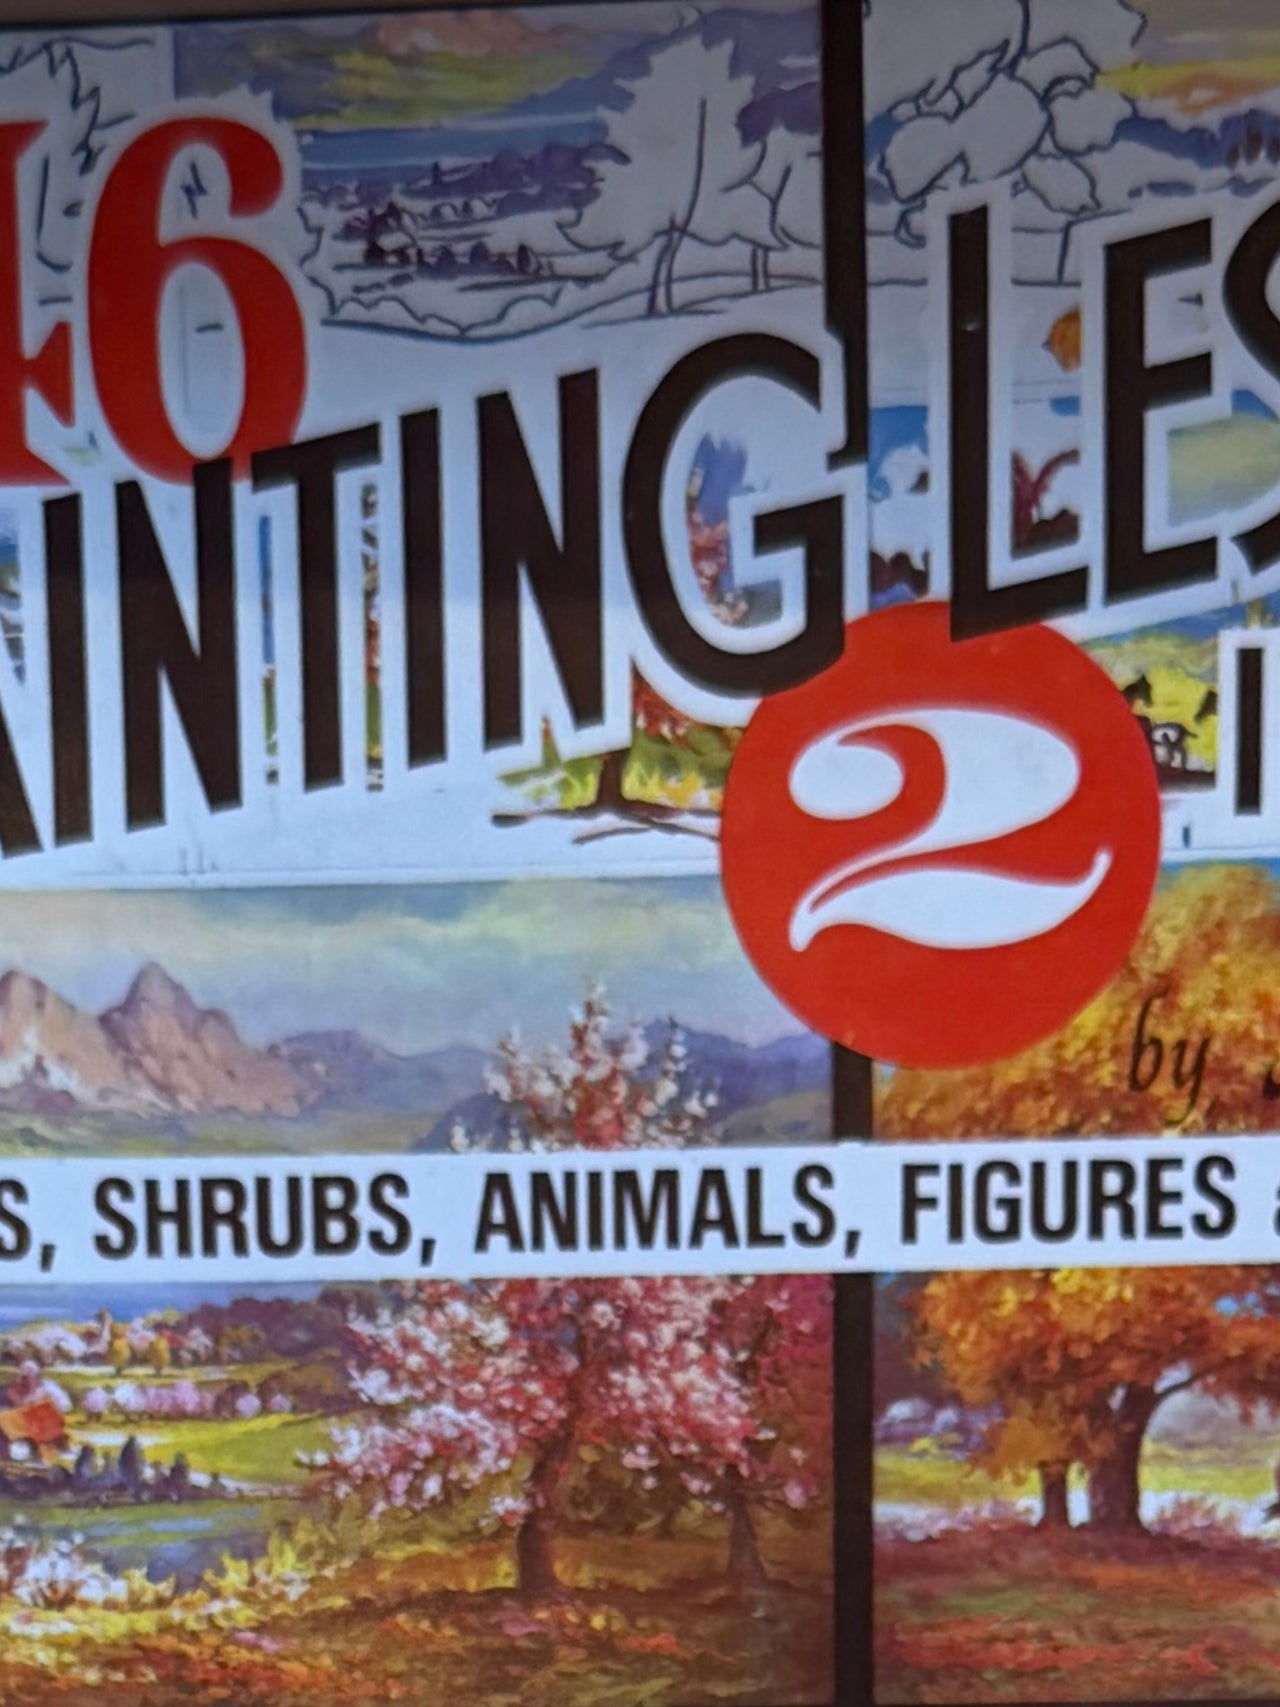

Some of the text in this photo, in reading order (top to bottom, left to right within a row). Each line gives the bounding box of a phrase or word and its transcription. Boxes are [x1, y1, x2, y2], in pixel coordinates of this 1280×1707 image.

[787, 708, 1112, 952] 2
[1128, 993, 1210, 1126] by
[93, 1170, 438, 1264] SHRUBS,
[474, 1163, 861, 1258] ANIMALS,
[899, 1155, 1237, 1246] FIGURES
